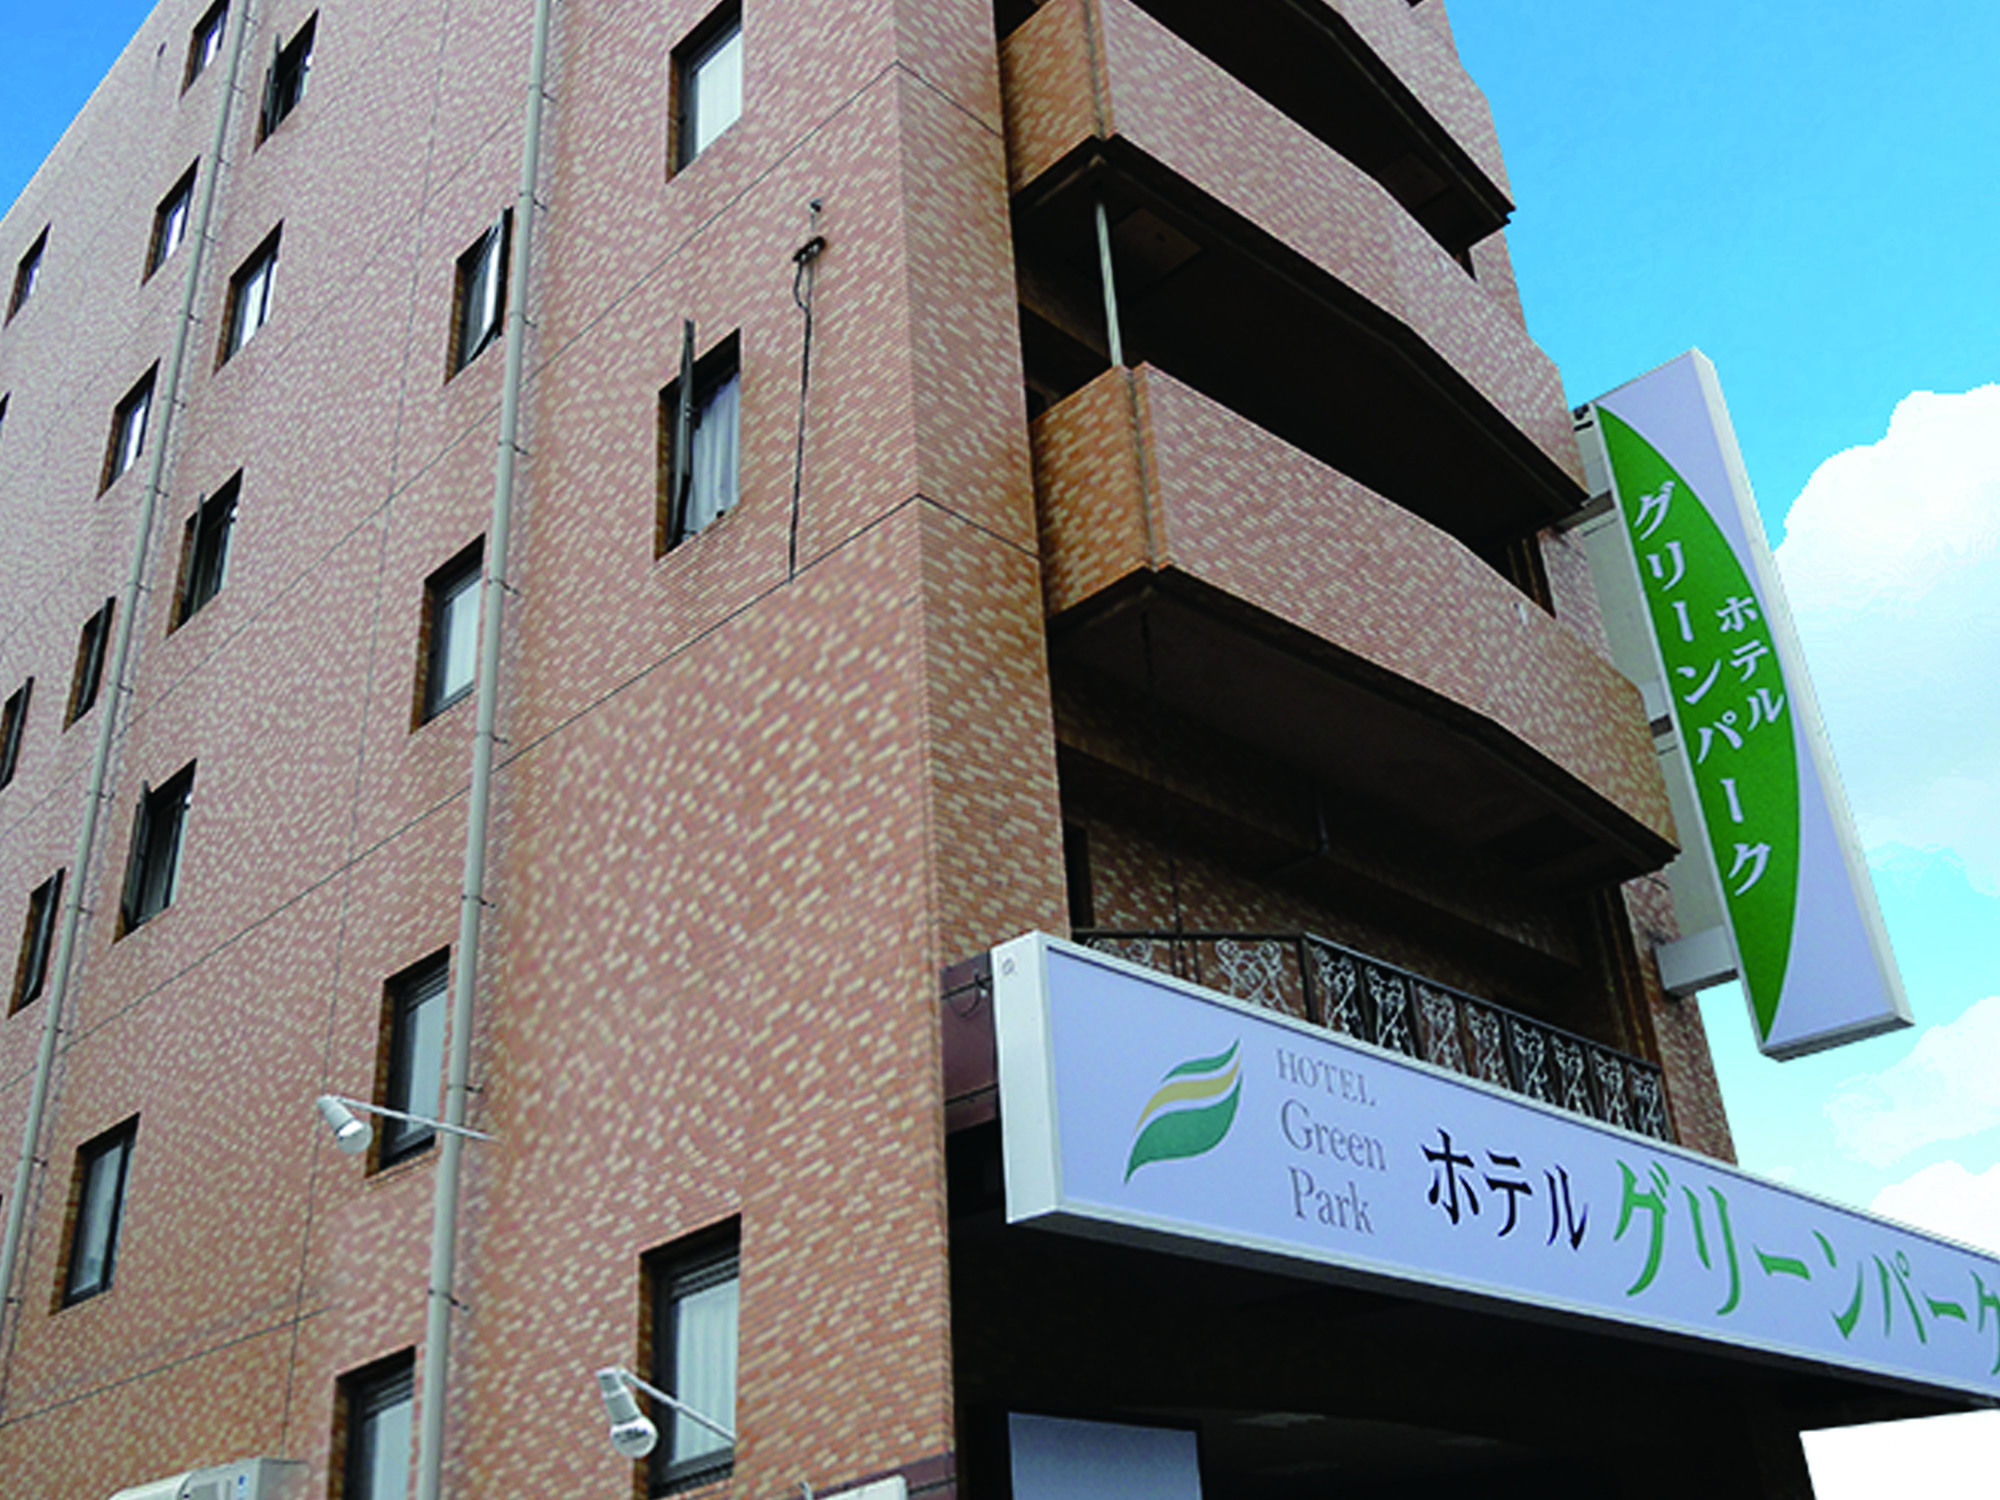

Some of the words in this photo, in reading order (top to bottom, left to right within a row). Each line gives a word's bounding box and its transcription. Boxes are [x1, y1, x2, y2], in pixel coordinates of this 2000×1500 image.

[1633, 479, 1772, 896] グリーンパーク
[1715, 596, 1786, 732] ホテル
[1276, 1048, 1377, 1108] HOTEL
[1281, 1098, 1387, 1171] Green
[1289, 1165, 1375, 1235] Park
[1420, 1127, 1589, 1251] ホテル
